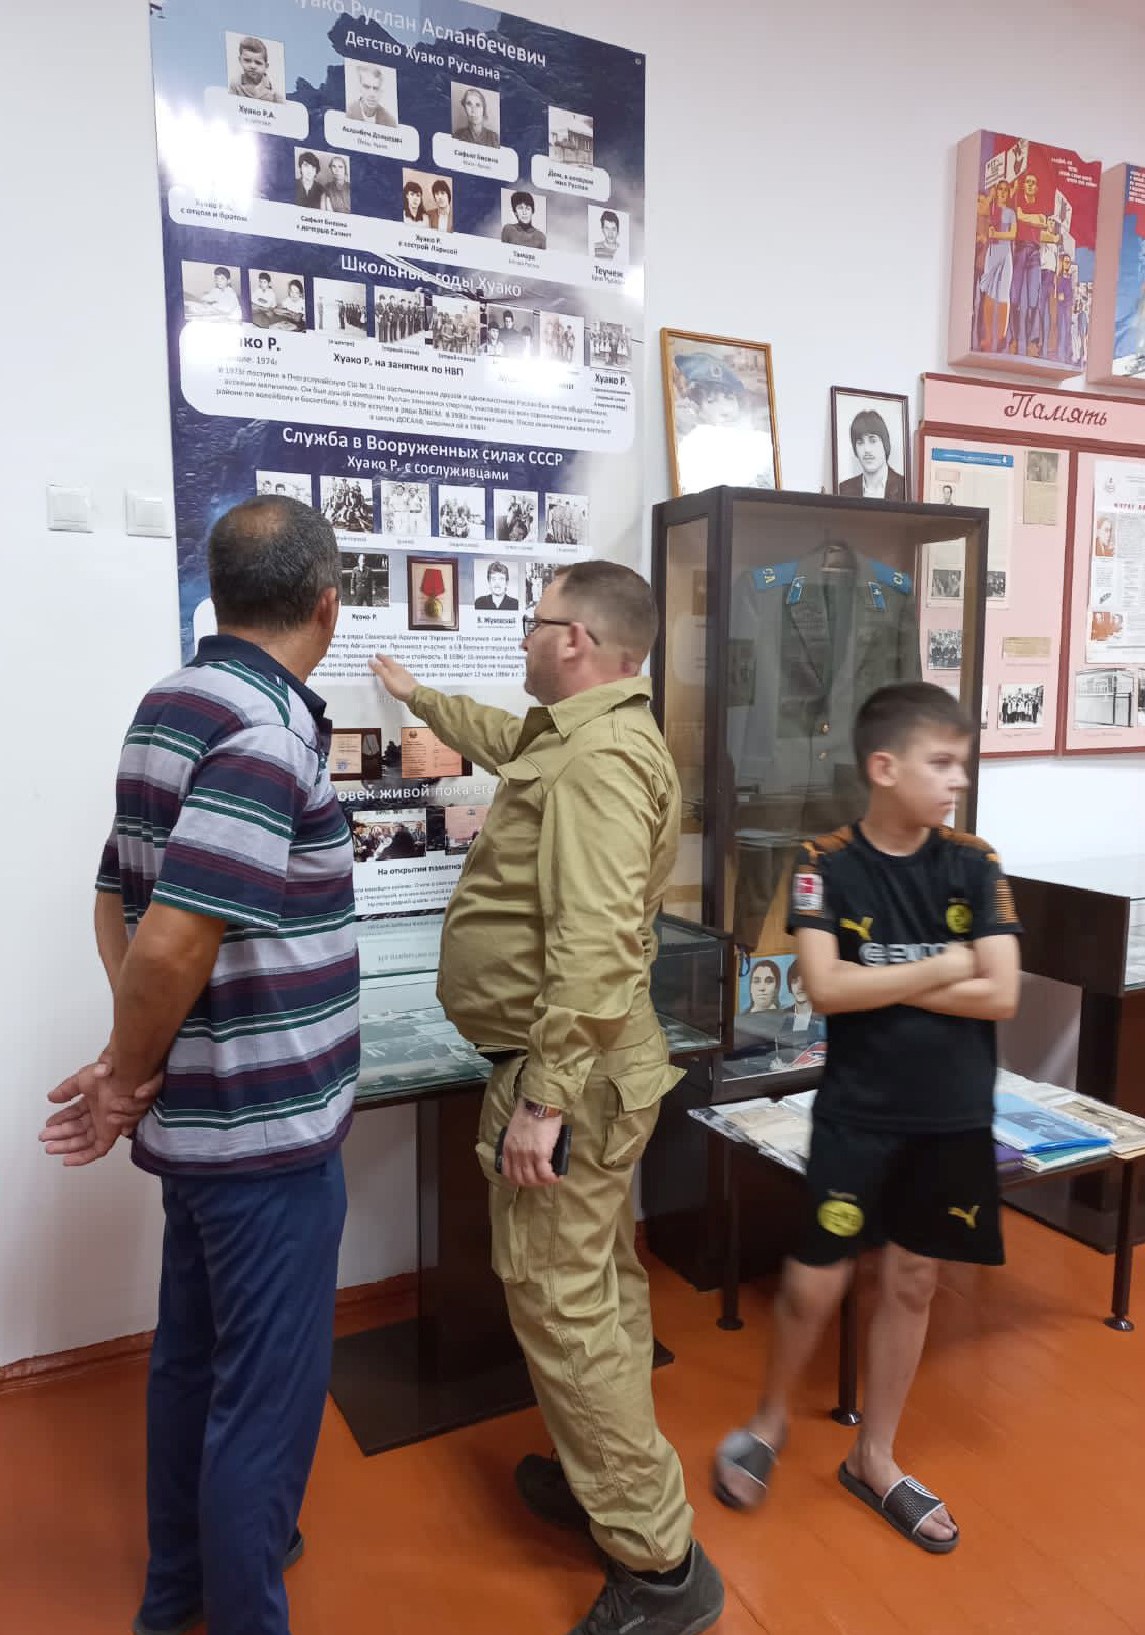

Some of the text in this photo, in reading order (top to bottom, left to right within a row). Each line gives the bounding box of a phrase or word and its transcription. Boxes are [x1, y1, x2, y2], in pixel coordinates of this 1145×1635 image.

[352, 0, 416, 32] Руслан
[423, 16, 546, 68] Асланбечевич
[345, 30, 500, 80] Детство Хуако Руслана
[333, 353, 362, 365] Хуако
[375, 360, 386, 368] на
[388, 361, 429, 372] занятиях
[444, 367, 464, 377] НВП
[1003, 391, 1108, 427] Память
[282, 427, 563, 466] Служба в Вооруженных силах СССР
[347, 455, 509, 481] Хуако Р. с сослуживцами
[379, 784, 430, 800] живой
[434, 784, 469, 797] пока
[377, 868, 388, 876] На
[389, 866, 427, 875] открытии
